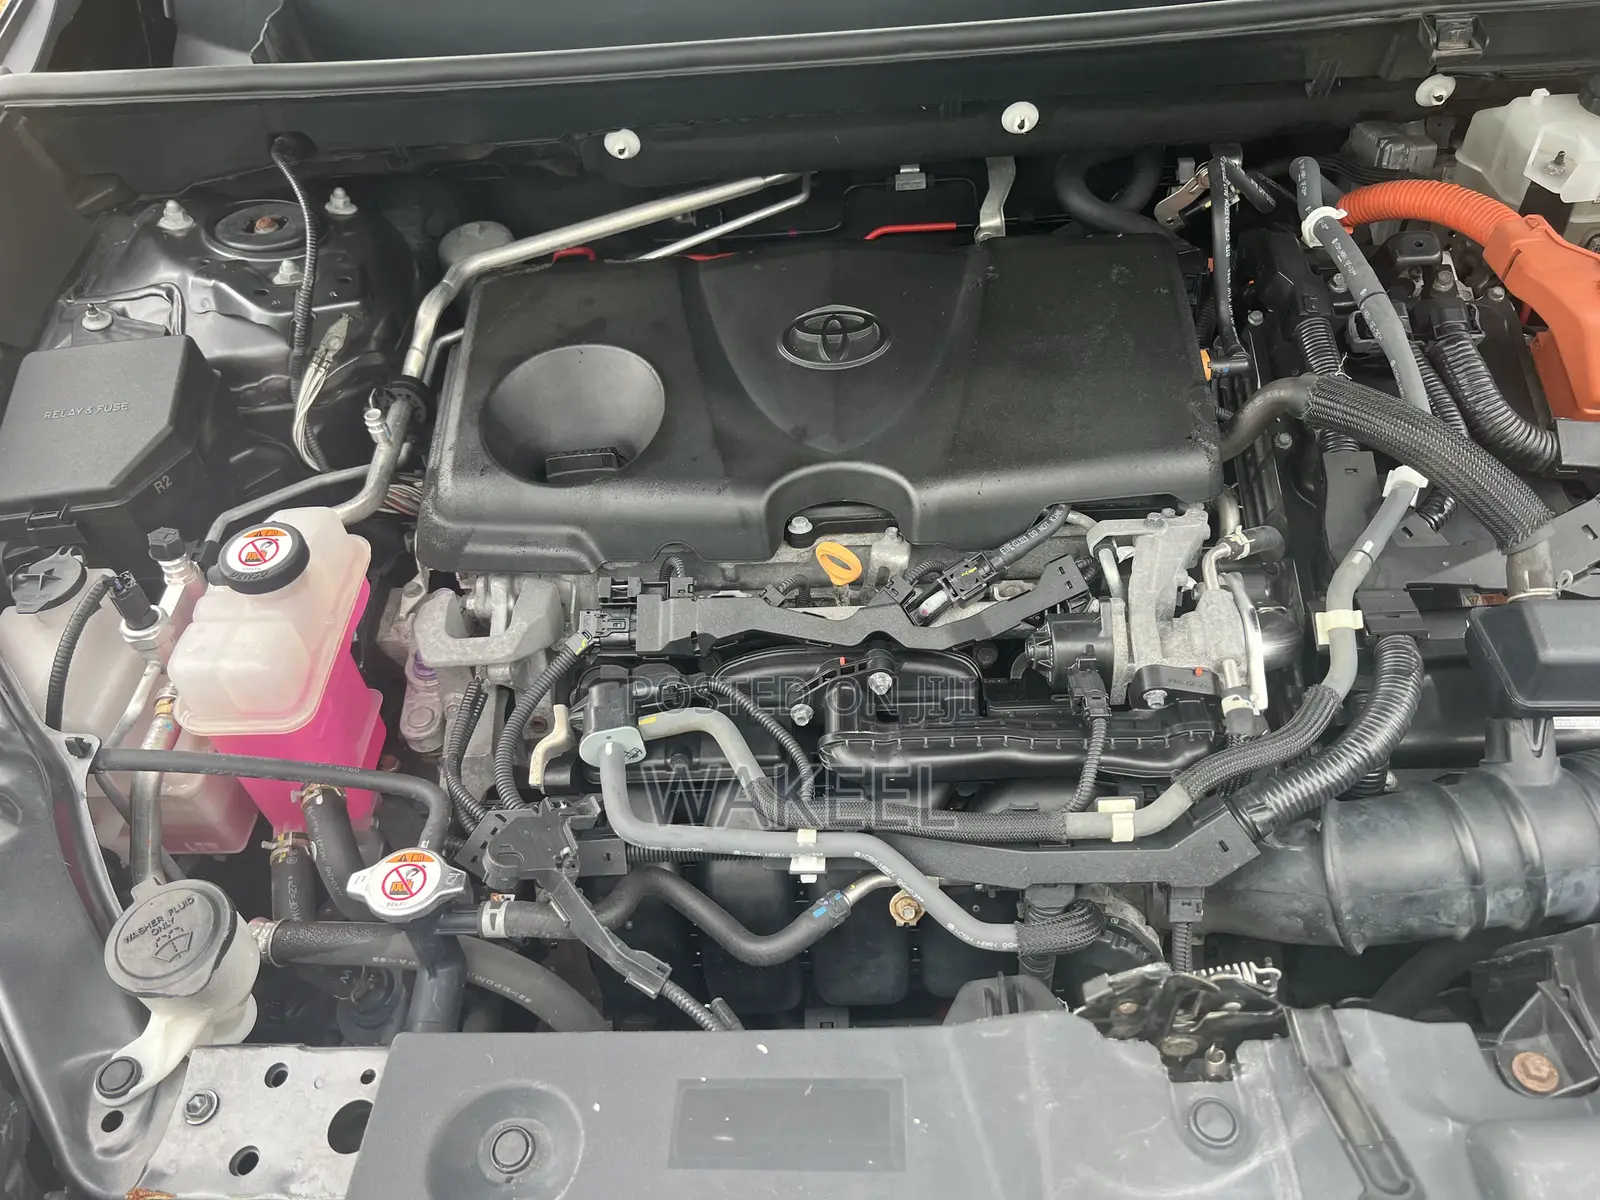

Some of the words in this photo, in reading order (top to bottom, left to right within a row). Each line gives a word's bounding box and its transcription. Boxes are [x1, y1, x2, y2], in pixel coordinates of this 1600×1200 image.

[43, 406, 83, 420] RELAY
[85, 405, 94, 415] &
[96, 401, 130, 414] FUSE
[153, 475, 173, 495] R2
[123, 915, 165, 945] WASHER
[168, 896, 195, 916] FLUID
[151, 916, 175, 936] ONLY
